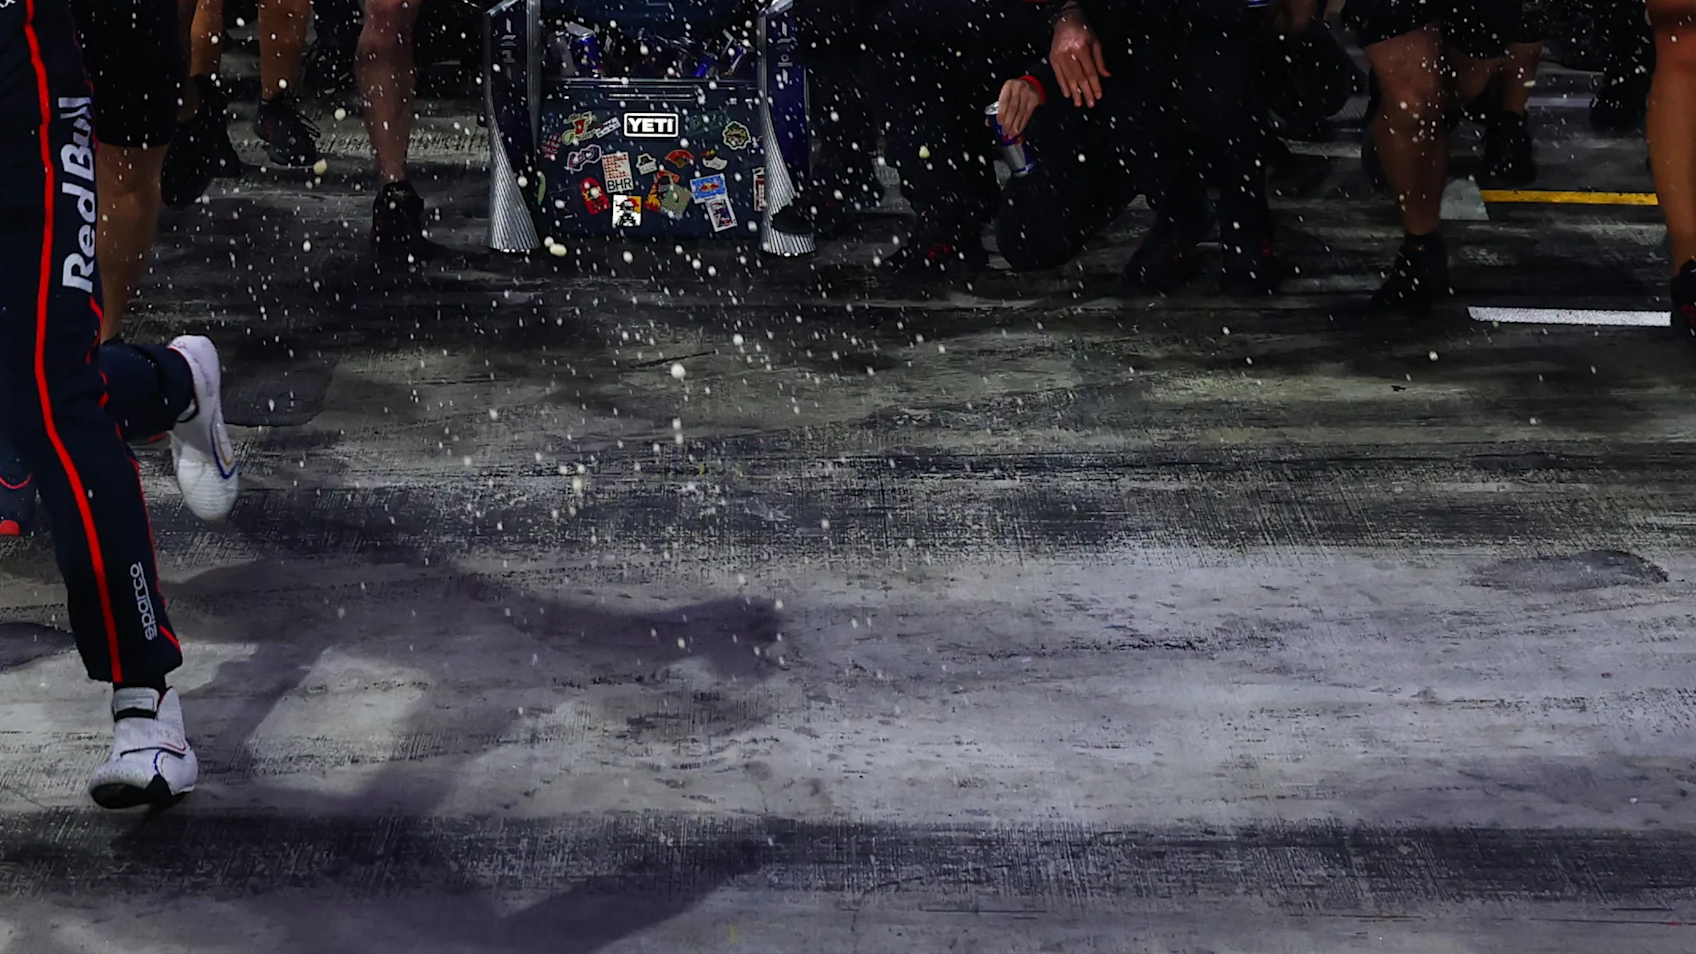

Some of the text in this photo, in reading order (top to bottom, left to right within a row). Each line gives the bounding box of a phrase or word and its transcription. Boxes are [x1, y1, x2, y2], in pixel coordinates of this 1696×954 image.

[628, 118, 674, 133] YETI
[607, 179, 633, 192] BHR
[58, 97, 97, 294] Red Bull
